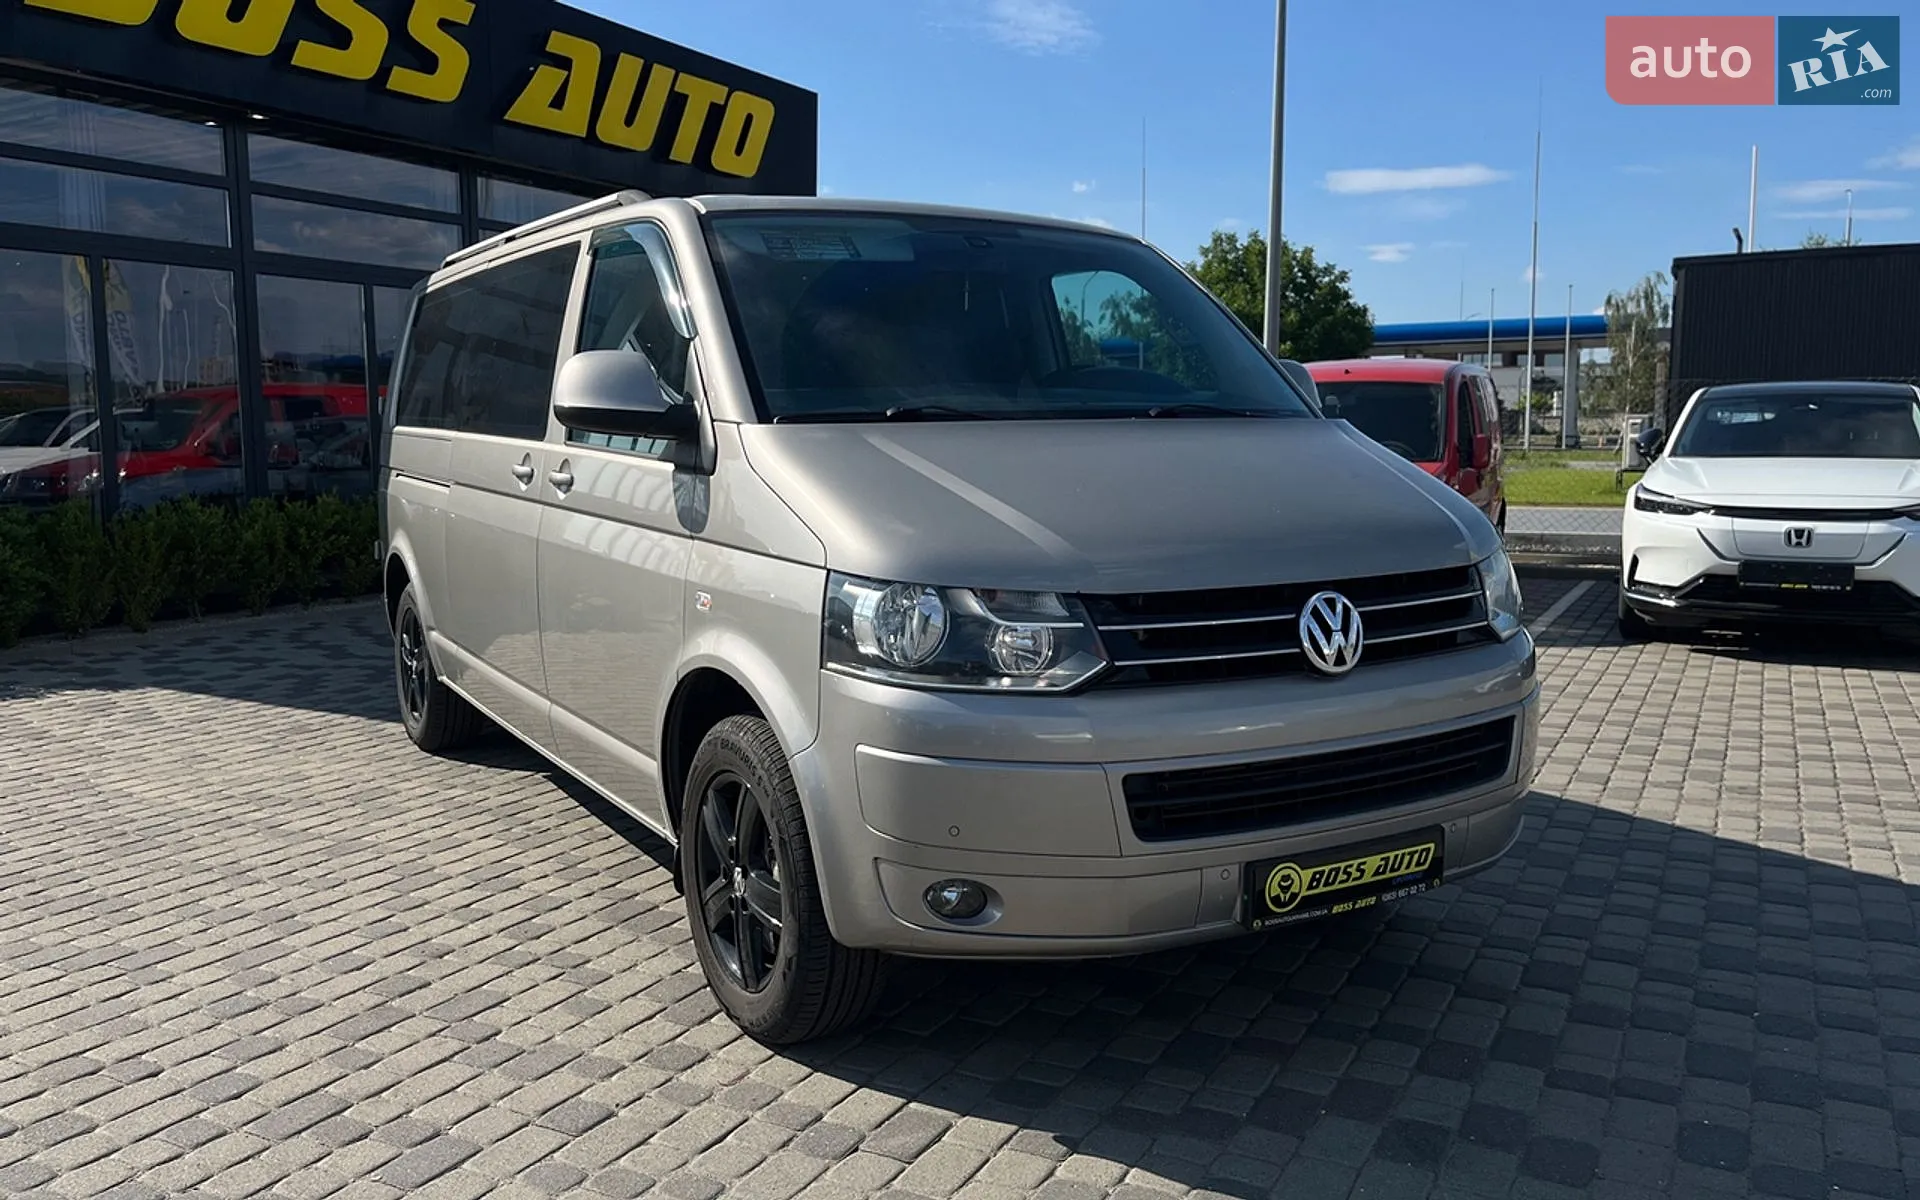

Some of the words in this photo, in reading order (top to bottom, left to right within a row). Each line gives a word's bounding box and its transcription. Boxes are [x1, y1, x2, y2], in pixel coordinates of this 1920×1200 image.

[24, 0, 476, 103] OSS
[504, 30, 775, 179] AUTO
[1306, 861, 1368, 891] BOSS
[1371, 846, 1431, 877] AUTO
